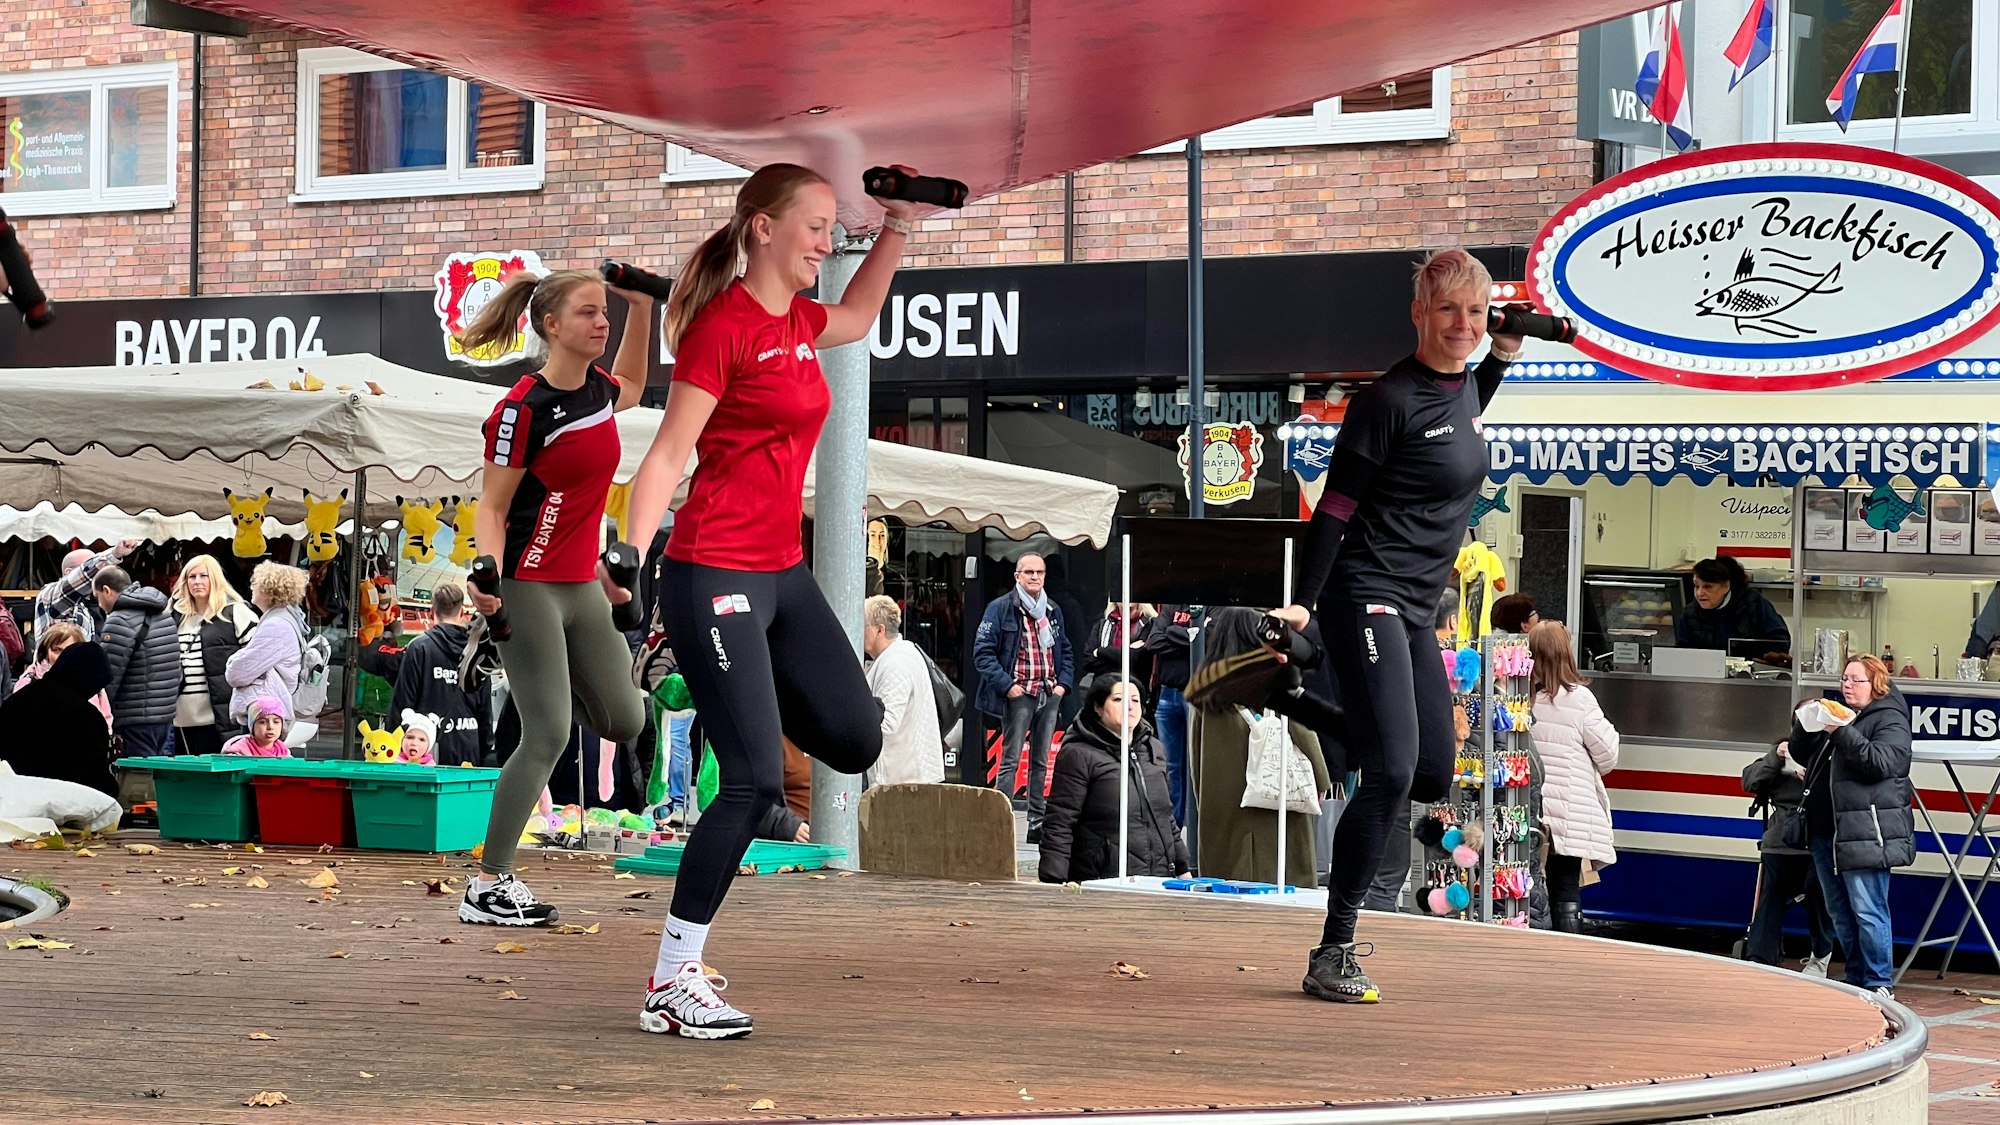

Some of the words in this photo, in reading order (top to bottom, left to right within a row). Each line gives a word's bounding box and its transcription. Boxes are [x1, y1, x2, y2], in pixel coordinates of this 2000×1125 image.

[1611, 88, 1638, 121] VR
[41, 133, 53, 144] und
[54, 131, 86, 145] Allgemein-
[25, 146, 64, 158] medizinische
[64, 145, 84, 156] Praxis
[1600, 216, 1744, 270] Heisser
[1751, 197, 1954, 270] Backfisch
[476, 263, 498, 274] 1904
[870, 291, 1019, 359] USEN
[115, 318, 257, 366] BAYER
[265, 316, 328, 360] 04
[758, 348, 783, 362] CRAFT
[1211, 430, 1229, 438] 1904
[1425, 426, 1450, 438] CRAFT
[1203, 459, 1237, 468] BAYER
[1733, 442, 1969, 473] BACKFISCH
[1204, 485, 1246, 498] verkusen
[524, 545, 544, 568] TSV
[534, 505, 560, 546] BAYER
[548, 491, 564, 504] 04
[710, 627, 728, 661] CRAFT
[1364, 628, 1378, 655] CRAFT
